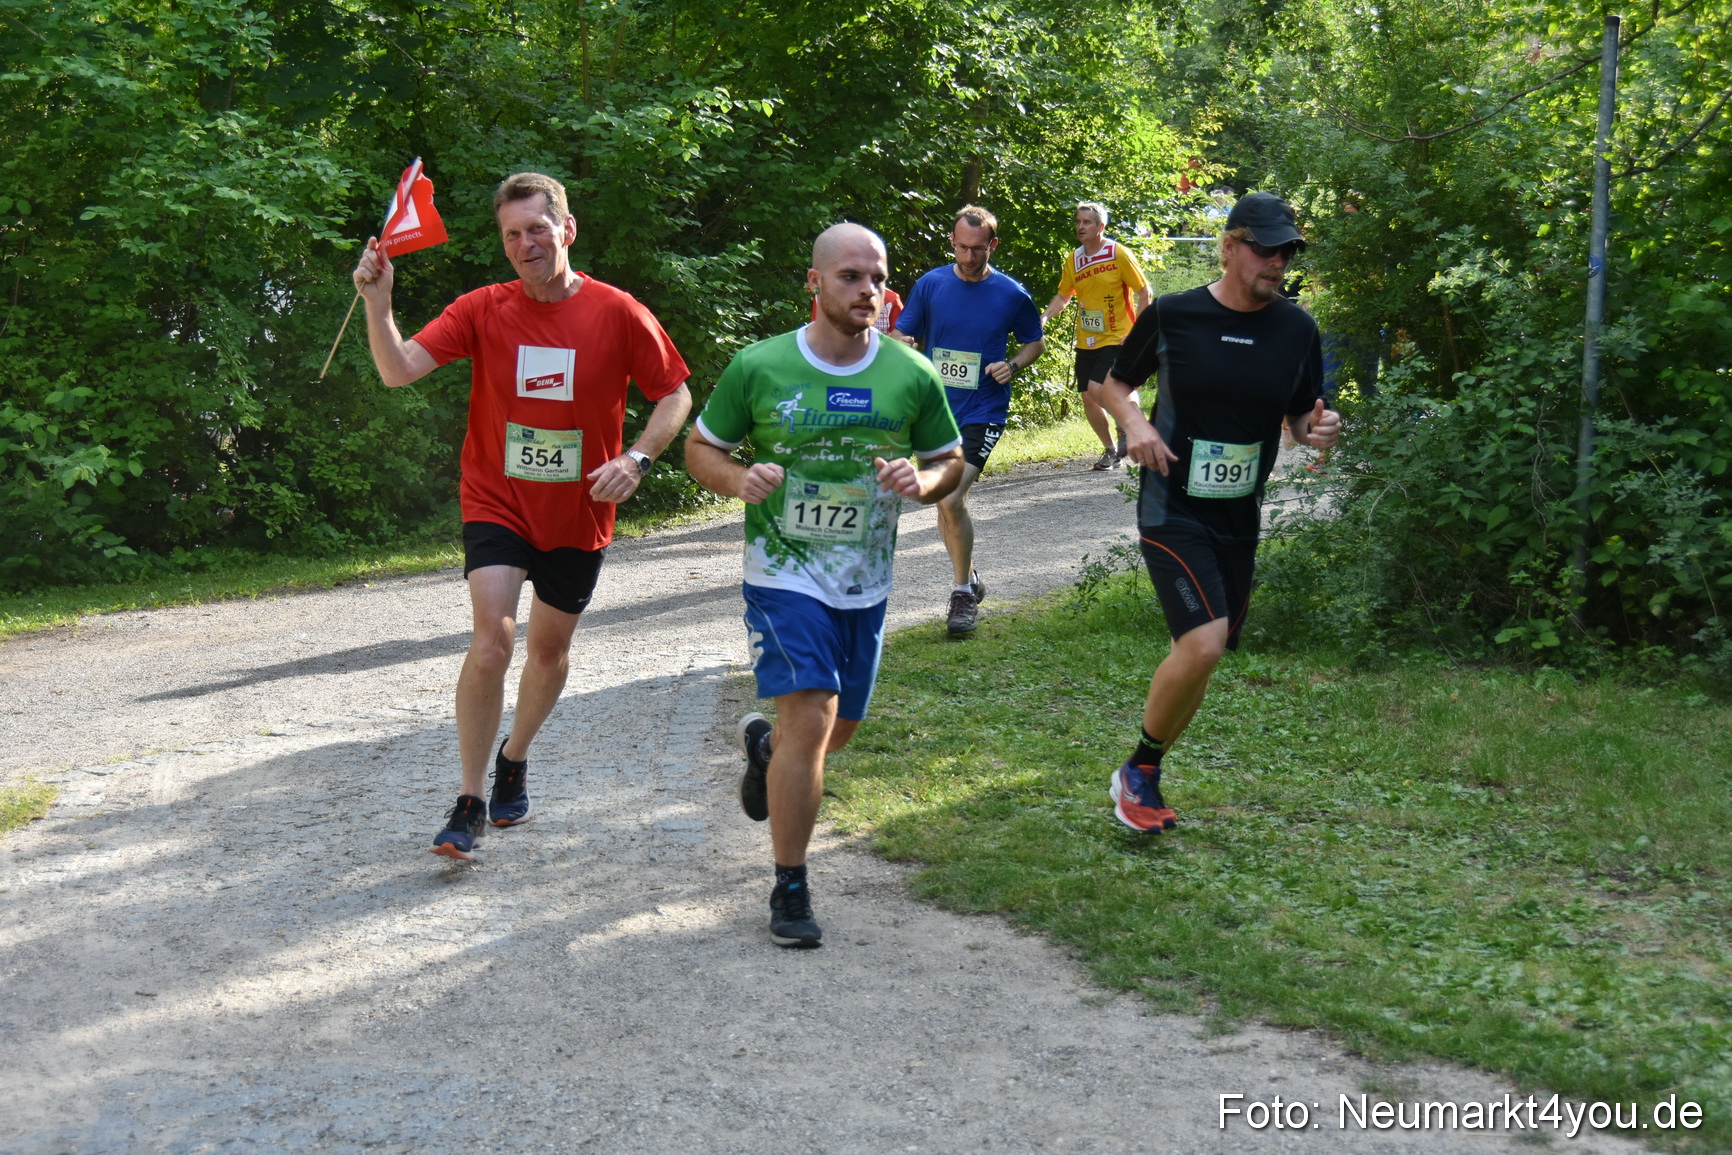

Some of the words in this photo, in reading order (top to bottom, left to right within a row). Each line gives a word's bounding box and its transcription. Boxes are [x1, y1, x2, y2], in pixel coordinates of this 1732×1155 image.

[394, 231, 424, 246] protects.
[1075, 270, 1092, 283] MAX
[1093, 263, 1118, 275] BÖGL
[1081, 317, 1101, 327] 1676
[941, 362, 968, 378] 869
[536, 378, 555, 387] DEHN
[836, 396, 869, 405] Fischer
[804, 408, 907, 433] firmenlauf
[978, 428, 1000, 460] NIKE
[521, 446, 564, 468] 554
[516, 463, 543, 473] Wittmann
[1200, 461, 1252, 483] 1991
[794, 502, 858, 529] 1172
[823, 527, 854, 535] Christian
[1175, 577, 1200, 612] OMM
